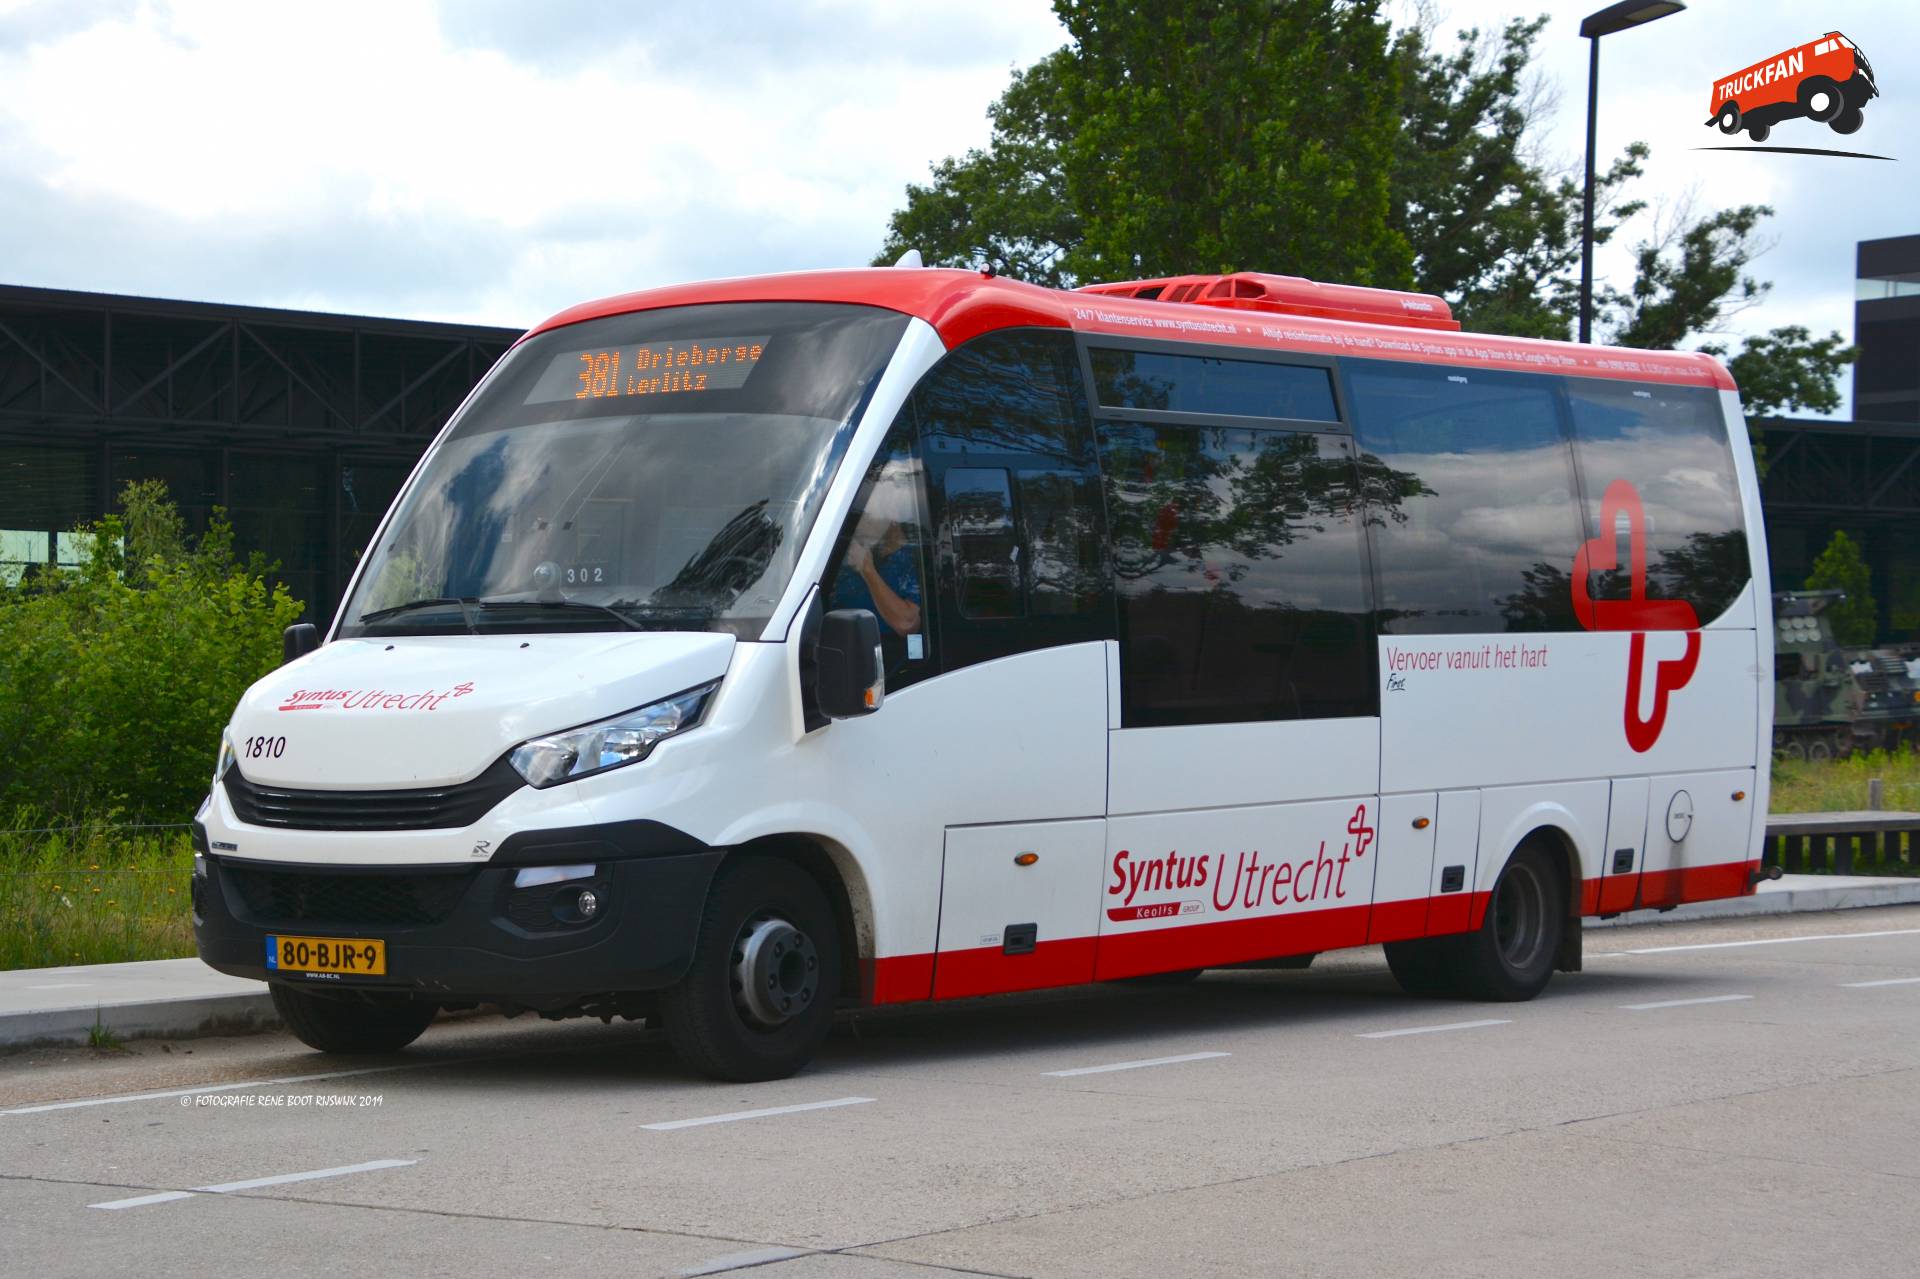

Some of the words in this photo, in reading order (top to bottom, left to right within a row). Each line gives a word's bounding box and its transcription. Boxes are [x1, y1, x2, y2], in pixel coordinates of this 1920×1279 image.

[1073, 307, 1095, 321] 24/7
[1096, 309, 1154, 328] klantenservice
[576, 352, 620, 399] 381
[567, 567, 603, 583] 302
[1387, 646, 1443, 672] Vervoer
[1446, 644, 1492, 669] vanuit
[1494, 643, 1517, 669] het
[1520, 642, 1549, 668] hart
[284, 689, 349, 706] Syntus
[343, 689, 451, 711] Utrecht
[245, 736, 286, 759] 1810
[1108, 850, 1210, 906] Syntus
[1213, 841, 1351, 912] Utrecht
[1136, 905, 1174, 919] Keolis
[283, 941, 377, 970] 80-BJR-9
